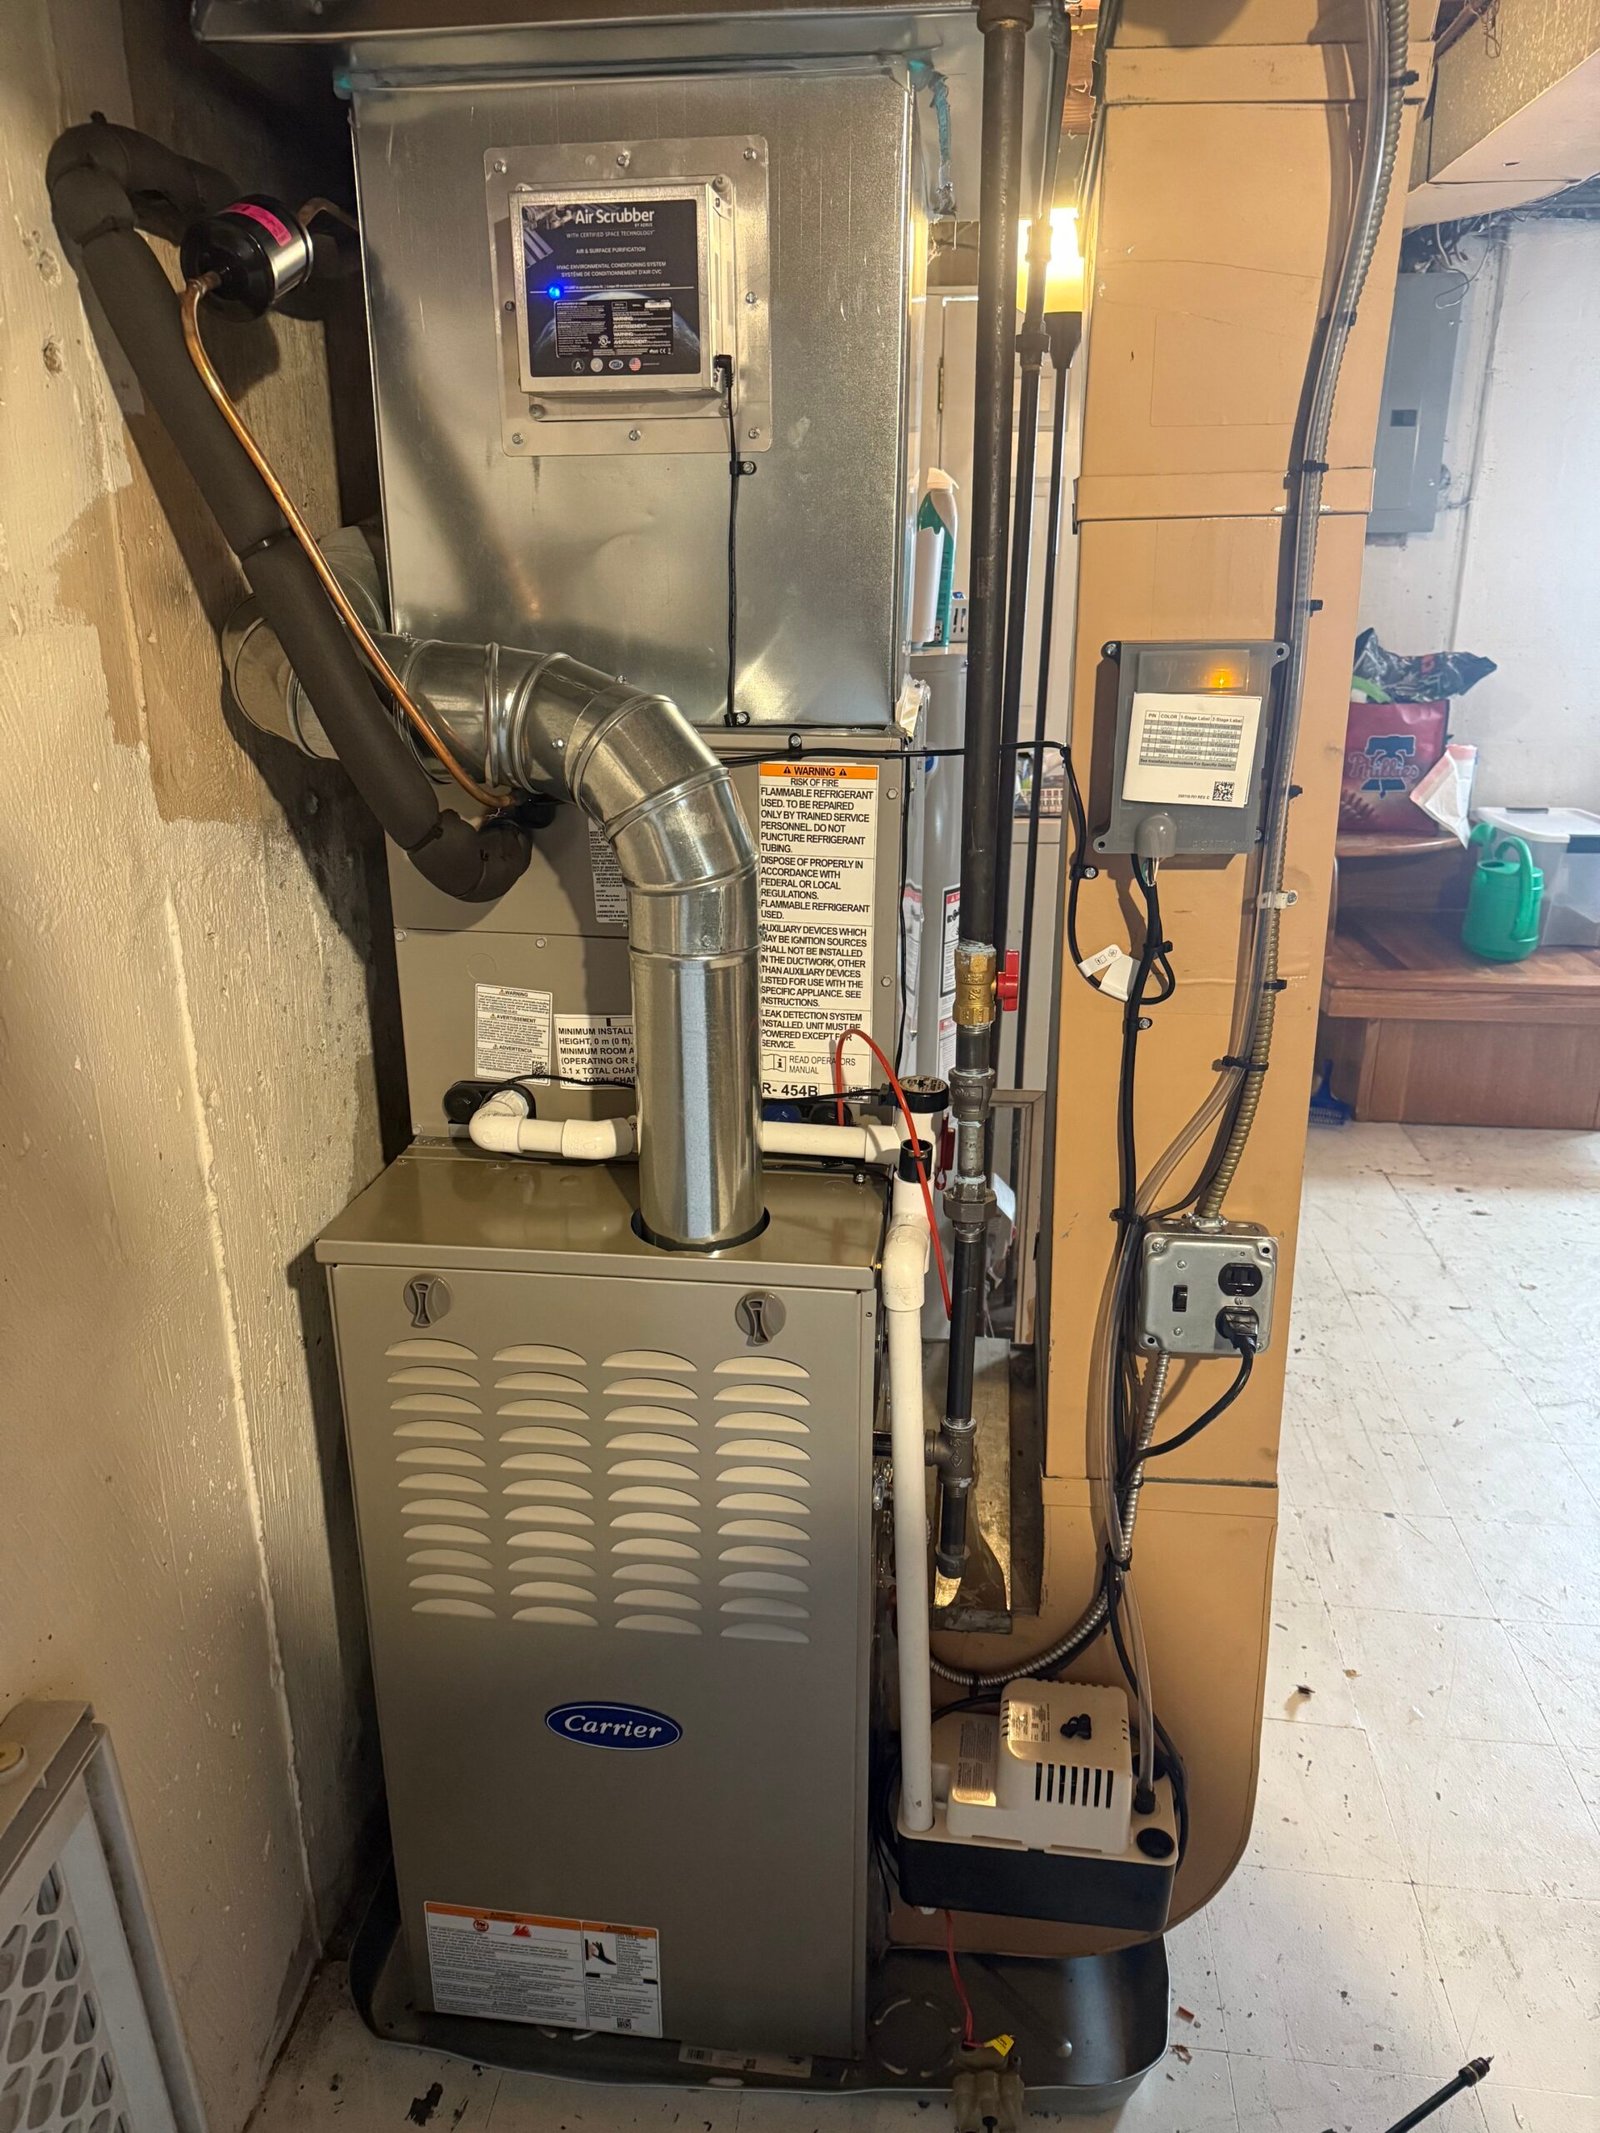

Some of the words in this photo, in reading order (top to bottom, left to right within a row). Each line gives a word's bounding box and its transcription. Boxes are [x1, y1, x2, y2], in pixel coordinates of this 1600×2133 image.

[575, 209, 593, 224] Air
[596, 207, 654, 223] Scrubber
[1348, 752, 1420, 779] Phillies
[794, 767, 835, 776] WARNING
[790, 778, 808, 786] RISK
[761, 787, 812, 798] FLAMMABLE
[814, 789, 874, 800] REFRIGERANT
[761, 799, 785, 808] USED.
[786, 800, 798, 808] TO
[800, 801, 811, 809] BE
[813, 801, 854, 810] REPAIRED
[761, 810, 782, 819] ONLY
[784, 811, 795, 819] BY
[796, 812, 832, 820] TRAINED
[834, 813, 870, 822] SERVICE
[761, 821, 812, 832] PERSONNEL.
[828, 825, 846, 833] NOT
[761, 832, 805, 842] PUNCTURE
[807, 835, 865, 845] REFRIGERANT
[761, 843, 793, 853] TUBING.
[761, 856, 795, 865] DISPOSE
[810, 859, 854, 868] PROPERLY
[855, 861, 863, 869] IN
[761, 867, 818, 878] ACCORDANCE
[820, 870, 840, 878] WITH
[761, 878, 798, 887] FEDERAL
[799, 879, 811, 888] OR
[813, 881, 841, 890] LOCAL
[761, 889, 819, 900] REGULATIONS.
[761, 899, 810, 910] FLAMMABLE
[812, 902, 870, 913] REFRIGERANT
[761, 910, 784, 919] USED.
[762, 924, 801, 933] AUXILIARY
[839, 928, 867, 936] WHICH
[791, 936, 825, 945] IGNITION
[827, 938, 867, 947] SOURCES
[762, 945, 786, 954] SHALL
[819, 948, 863, 957] INSTALLED
[770, 956, 785, 964] THE
[787, 957, 836, 967] DUCTWORK,
[761, 966, 782, 974] THAN
[783, 967, 825, 976] AUXILIARY
[826, 969, 861, 978] DEVICES
[761, 976, 787, 985] LISTED
[761, 986, 795, 996] SPECIFIC
[797, 988, 844, 998] APPLIANCE.
[761, 996, 820, 1006] INSTRUCTIONS.
[497, 1015, 536, 1023] AVERTISSEMENT
[762, 1010, 781, 1018] LEAK
[783, 1011, 829, 1020] DETECTION
[830, 1013, 862, 1022] SYSTEM
[762, 1020, 804, 1029] NSTALLED.
[761, 1030, 800, 1039] POWERED
[762, 1039, 796, 1049] SERVICE.
[789, 1056, 809, 1064] READ
[811, 1057, 856, 1066] OPERAORS
[789, 1066, 819, 1074] MANUAL
[762, 1082, 777, 1094] R-
[781, 1084, 818, 1097] 454B
[564, 1715, 662, 1738] Carrier
